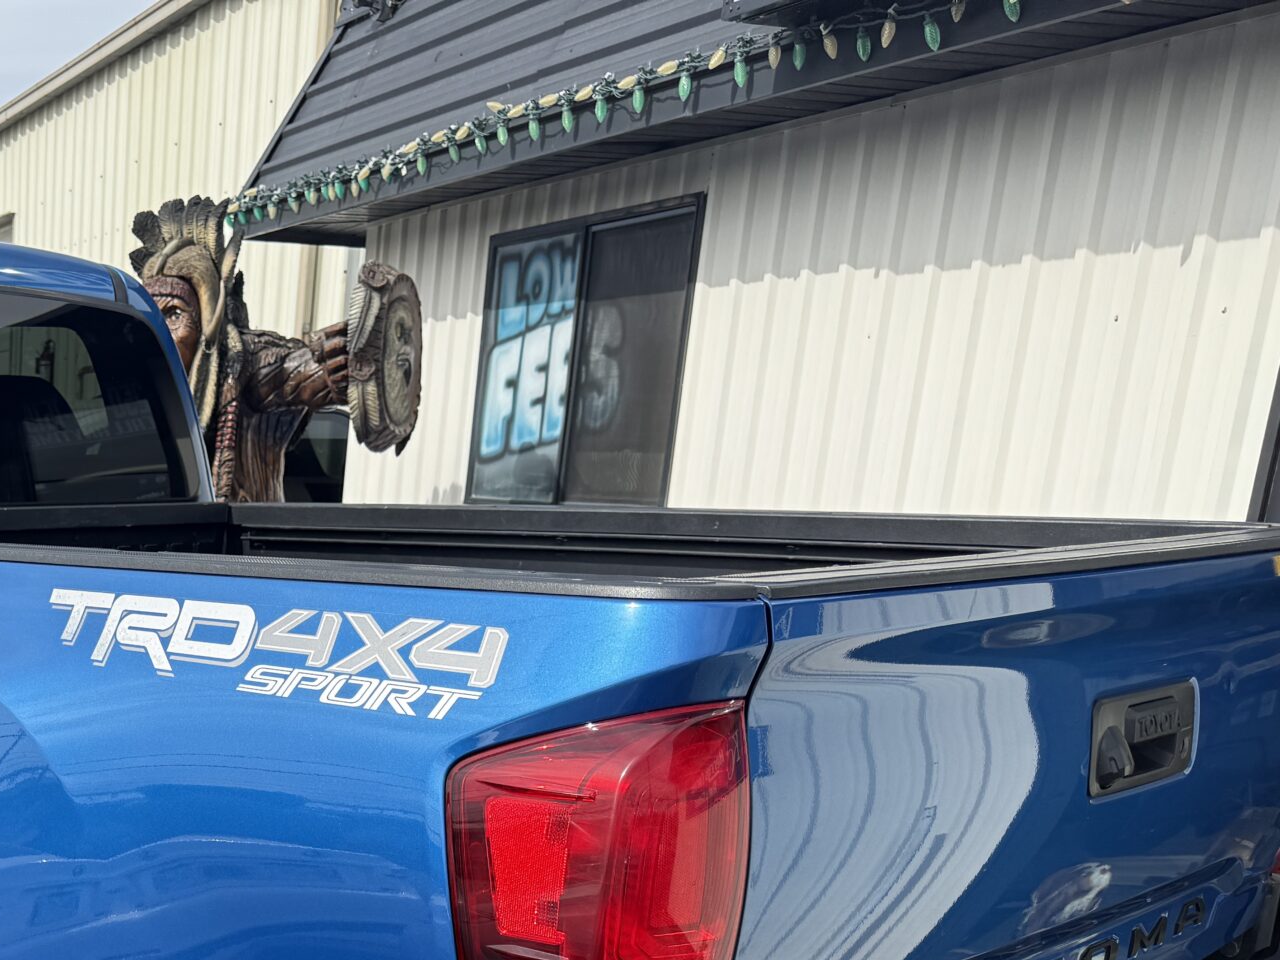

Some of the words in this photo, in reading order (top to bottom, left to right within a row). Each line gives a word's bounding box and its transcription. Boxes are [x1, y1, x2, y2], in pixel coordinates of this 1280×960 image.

[497, 240, 581, 342] LOW
[477, 303, 626, 463] FEES
[49, 587, 258, 677] TRD
[236, 664, 483, 720] SPORT
[1137, 710, 1182, 738] TOYOTA
